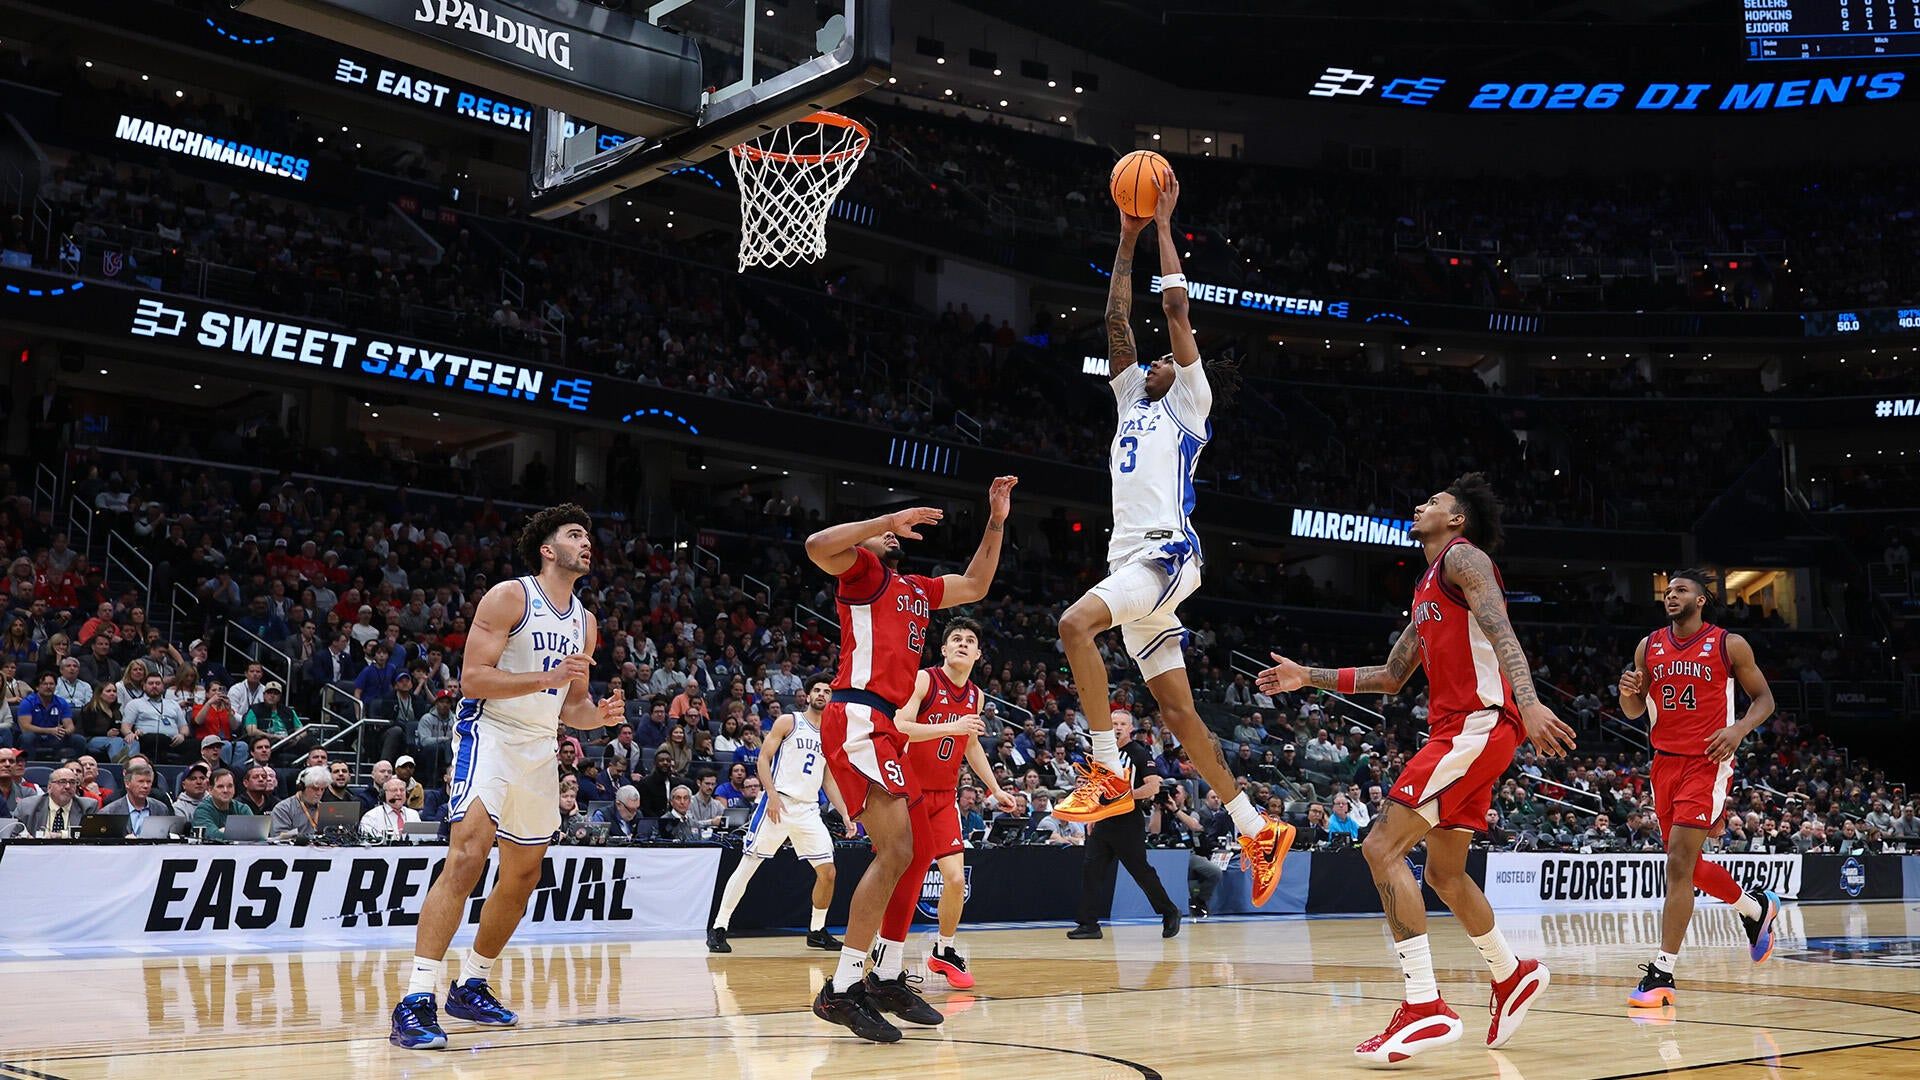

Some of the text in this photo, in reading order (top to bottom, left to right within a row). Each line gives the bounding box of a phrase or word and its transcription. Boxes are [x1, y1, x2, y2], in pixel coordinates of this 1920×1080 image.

[1745, 10, 1792, 21] HOPKINS
[1841, 8, 1849, 19] 6
[1866, 7, 1873, 18] 2
[1889, 6, 1896, 17] 1
[1746, 22, 1789, 33] EJIOFOR
[1842, 20, 1850, 31] 2
[1867, 19, 1874, 30] 1
[1890, 19, 1897, 30] 2
[415, 0, 572, 70] SPALDING
[376, 69, 450, 107] EAST
[1469, 71, 1906, 110] 2026 DI MEN'S
[115, 114, 310, 182] MARCHMADNESS
[1187, 282, 1323, 316] WEET SIXTEEN
[1837, 321, 1860, 332] 50.0
[197, 311, 544, 401] SWEET SIXTEEN
[1119, 436, 1138, 474] 3
[1667, 660, 1712, 682] JOHN'S
[1661, 684, 1697, 711] 24
[803, 753, 816, 775] 2
[937, 736, 956, 762] 0
[144, 858, 333, 932] EAST
[1496, 871, 1525, 884] HOSTED
[1526, 871, 1537, 884] BY
[1540, 860, 1668, 900] GEORGETOW
